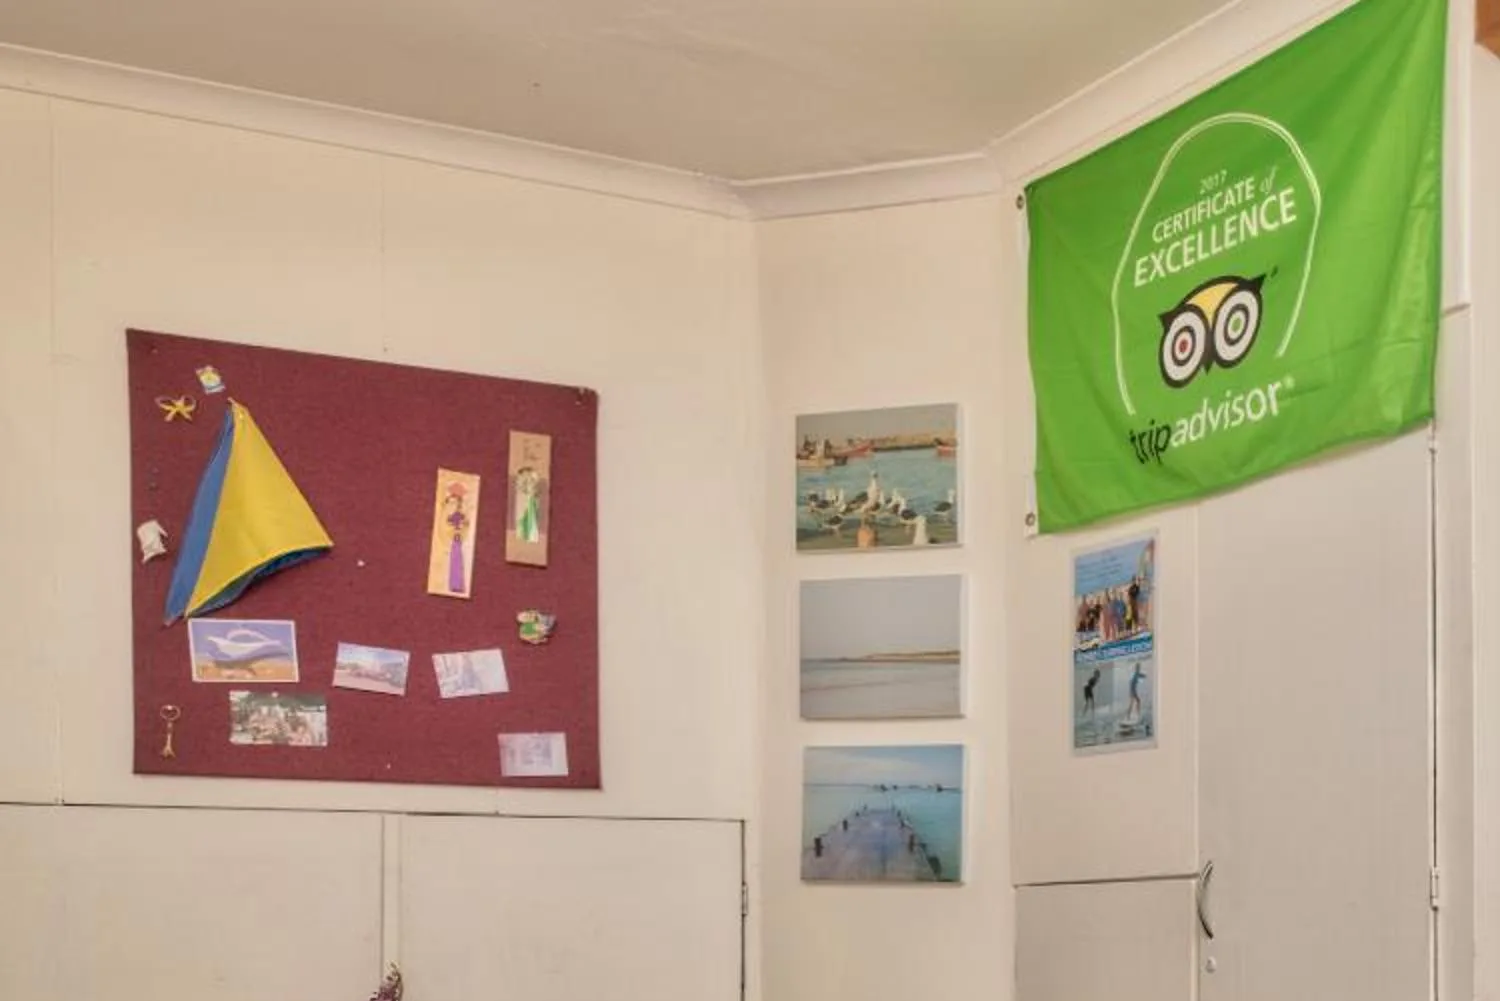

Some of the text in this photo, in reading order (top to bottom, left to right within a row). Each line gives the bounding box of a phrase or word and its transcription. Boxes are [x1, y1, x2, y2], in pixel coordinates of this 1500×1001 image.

[1134, 187, 1297, 288] EXCELLENCE
[1152, 177, 1256, 243] CERTIFICATE
[1129, 381, 1282, 465] tripadvisor
